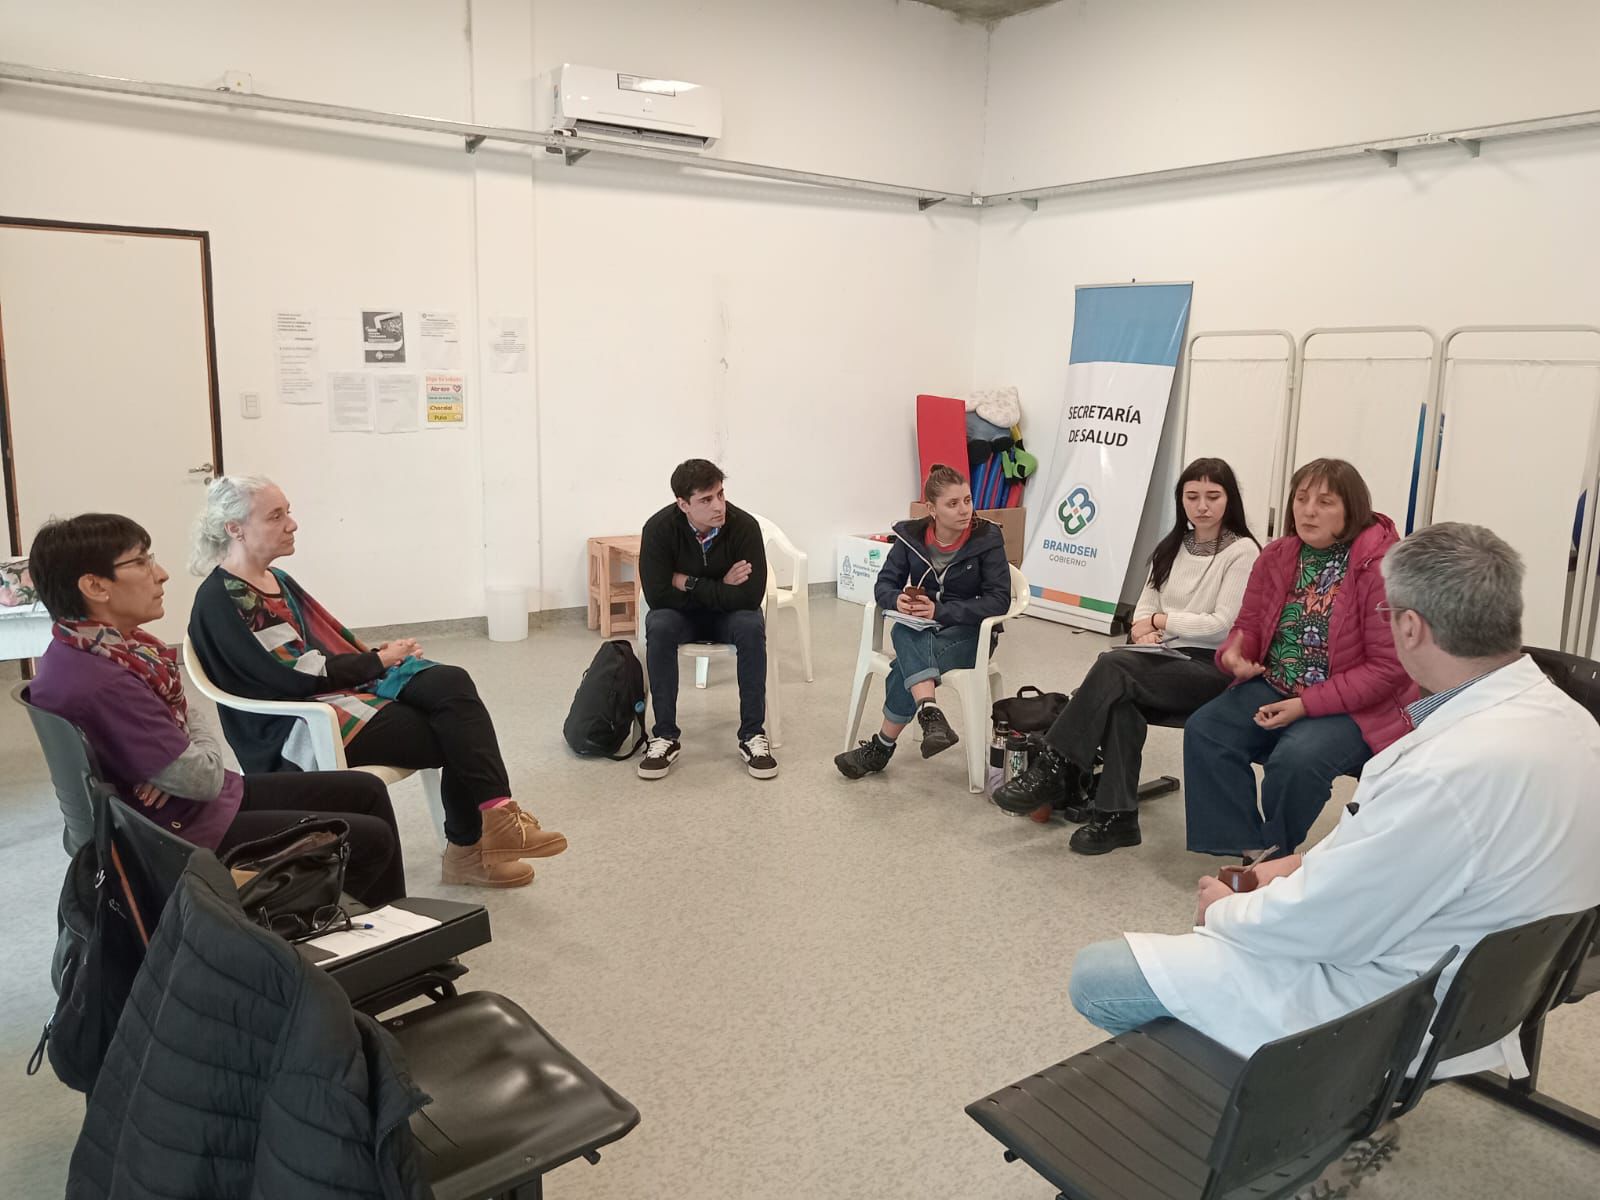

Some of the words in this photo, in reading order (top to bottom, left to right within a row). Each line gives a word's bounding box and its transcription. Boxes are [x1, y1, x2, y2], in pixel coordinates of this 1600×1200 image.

[1068, 405, 1141, 424] SECRETARÍA
[1068, 429, 1081, 442] DE
[1079, 428, 1128, 446] SALUD
[1043, 539, 1098, 559] BRANDSEN
[1049, 554, 1087, 567] GOBIERNO
